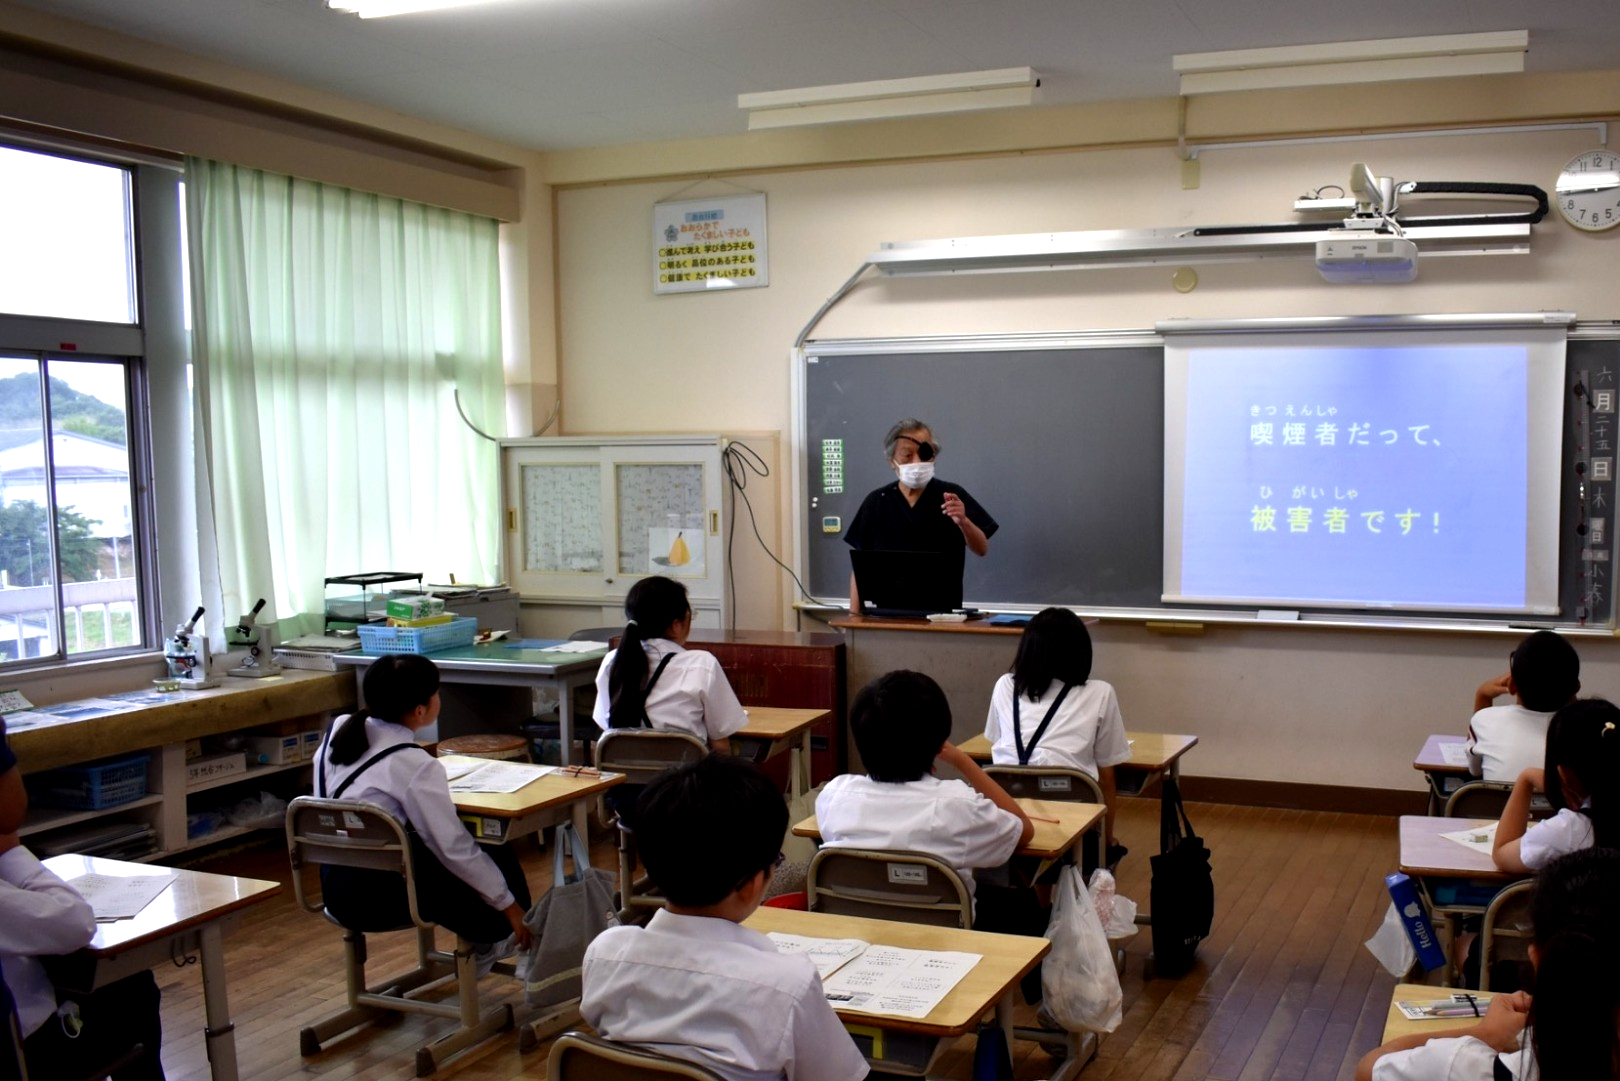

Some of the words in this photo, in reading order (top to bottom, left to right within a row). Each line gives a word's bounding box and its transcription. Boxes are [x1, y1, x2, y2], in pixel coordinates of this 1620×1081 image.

[1580, 161, 1587, 172] 11
[1593, 156, 1602, 168] 12
[1567, 199, 1575, 210] 8
[1579, 209, 1586, 220] 7
[1592, 212, 1599, 223] 6
[1605, 208, 1612, 219] 5
[1249, 421, 1441, 447] 喫煙者だって、
[1250, 505, 1440, 535] 被害者です！
[1414, 921, 1432, 949] Hello
